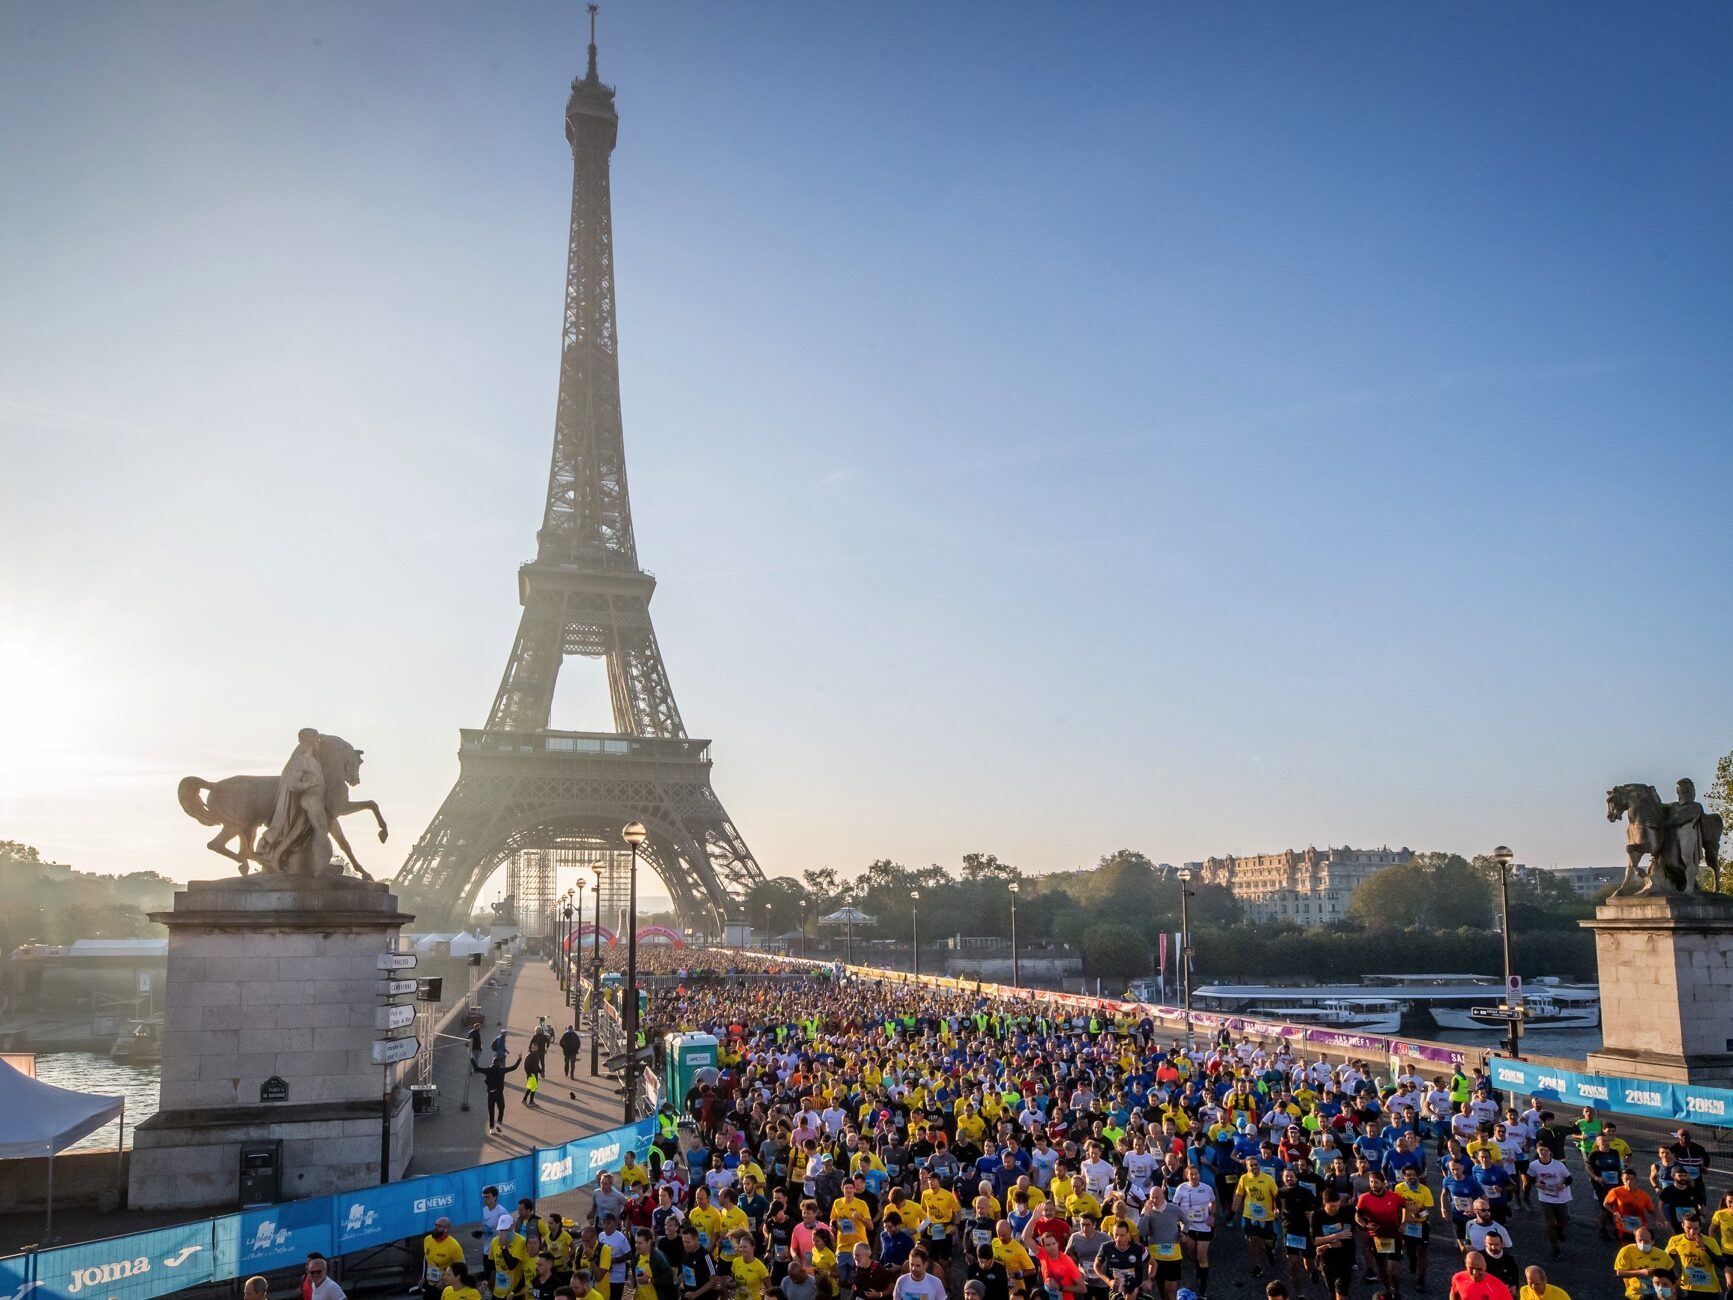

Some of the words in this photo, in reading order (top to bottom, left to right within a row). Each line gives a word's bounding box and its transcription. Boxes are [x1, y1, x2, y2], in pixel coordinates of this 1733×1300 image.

[1334, 1034, 1347, 1044] SAS
[1498, 1068, 1524, 1085] 20KM
[1577, 1083, 1608, 1100] 20KM
[1625, 1089, 1661, 1107] 20KM
[1686, 1096, 1725, 1115] 20KM
[588, 1142, 620, 1168] 20KM
